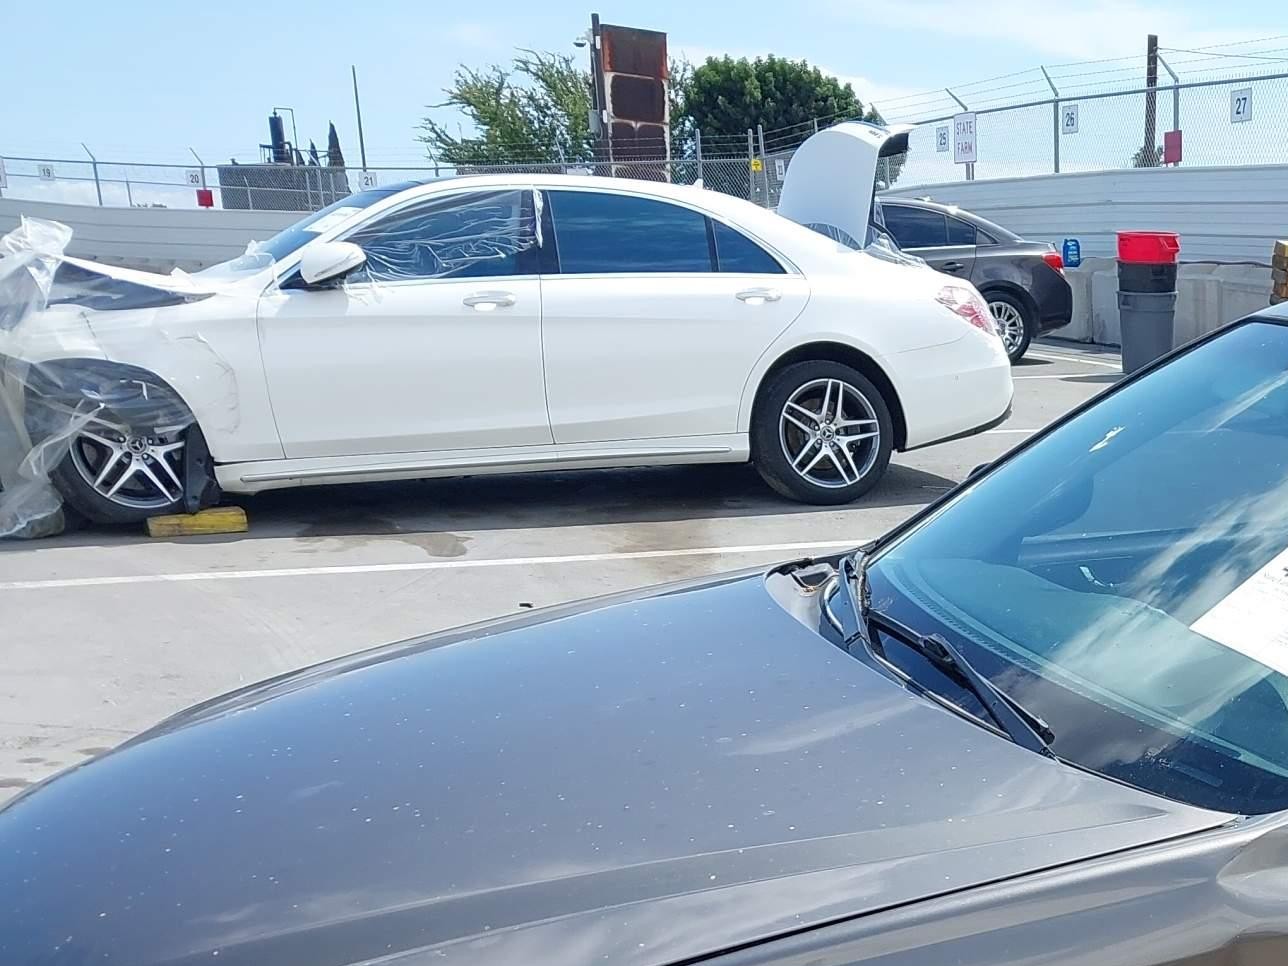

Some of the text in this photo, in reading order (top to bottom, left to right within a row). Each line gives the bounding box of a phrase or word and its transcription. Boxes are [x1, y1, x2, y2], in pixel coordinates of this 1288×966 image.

[1235, 97, 1248, 115] 27
[1065, 111, 1075, 127] 26
[956, 120, 973, 136] STATE
[939, 132, 947, 146] 25
[957, 141, 973, 156] FARM
[42, 168, 51, 178] 19
[190, 174, 199, 184] 20
[363, 176, 374, 186] 21
